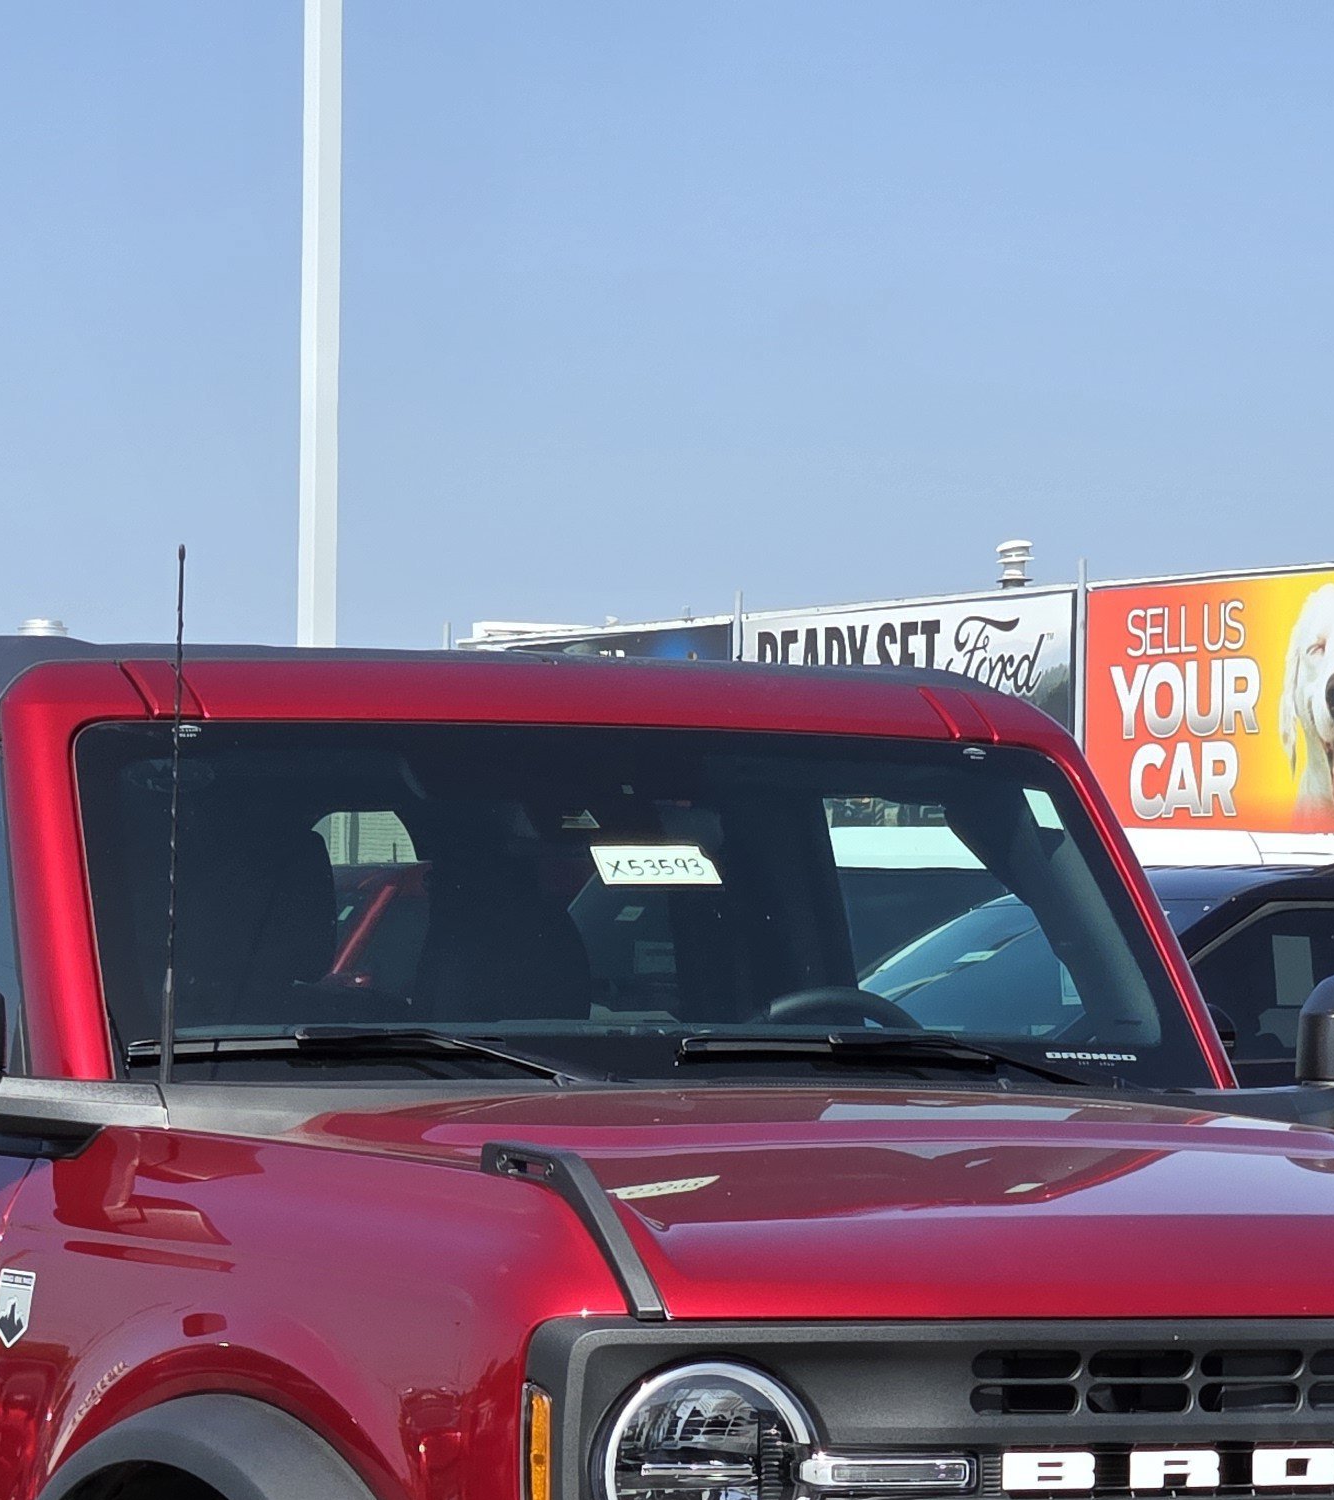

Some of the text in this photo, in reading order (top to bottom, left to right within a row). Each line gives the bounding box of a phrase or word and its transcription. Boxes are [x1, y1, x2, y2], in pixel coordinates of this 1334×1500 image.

[876, 620, 941, 669] SET
[945, 615, 1046, 694] Ford
[1126, 600, 1246, 657] SELL US
[1110, 657, 1261, 740] YOUR
[1129, 740, 1239, 820] CAR
[605, 857, 705, 878] X53593
